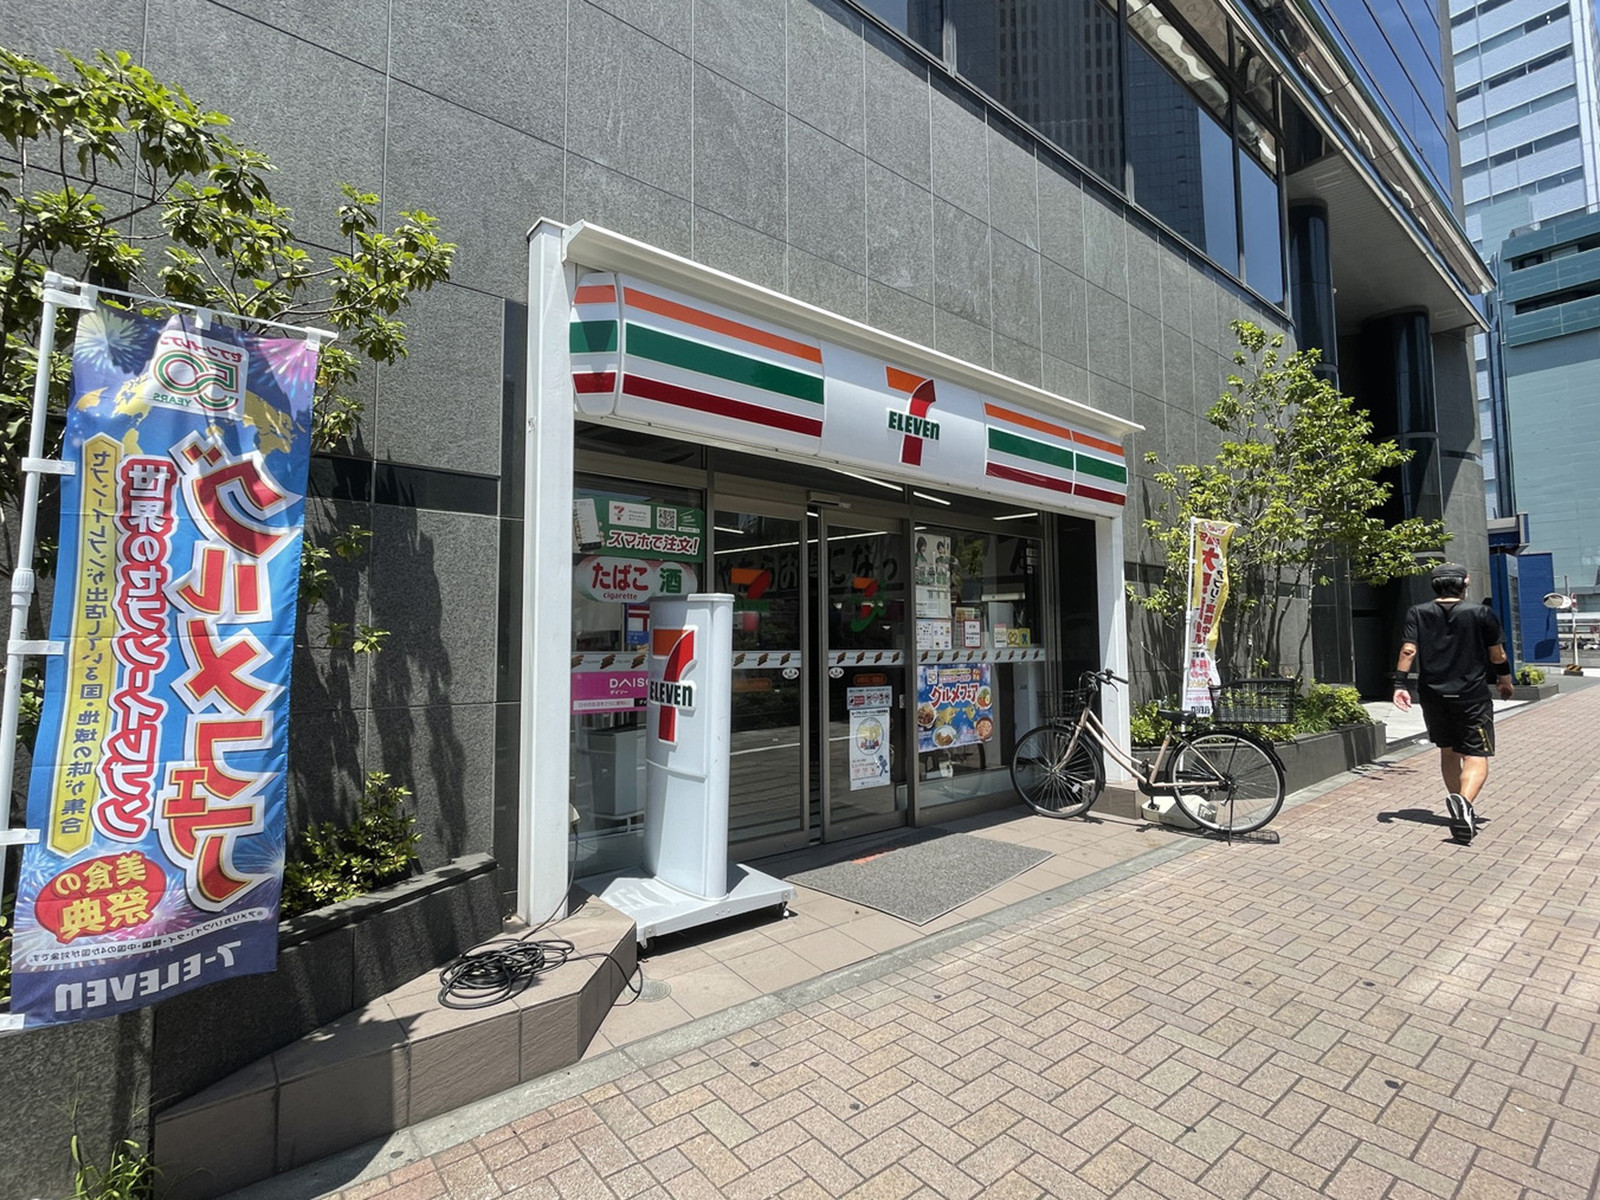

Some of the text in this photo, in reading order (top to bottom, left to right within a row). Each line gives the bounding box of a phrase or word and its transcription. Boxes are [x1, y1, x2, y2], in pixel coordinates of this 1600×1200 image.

[592, 562, 649, 591] たばこ
[659, 567, 682, 594] 酒
[603, 592, 638, 600] cigarette
[609, 677, 648, 688] DAIS
[930, 685, 979, 708] グルメフェア
